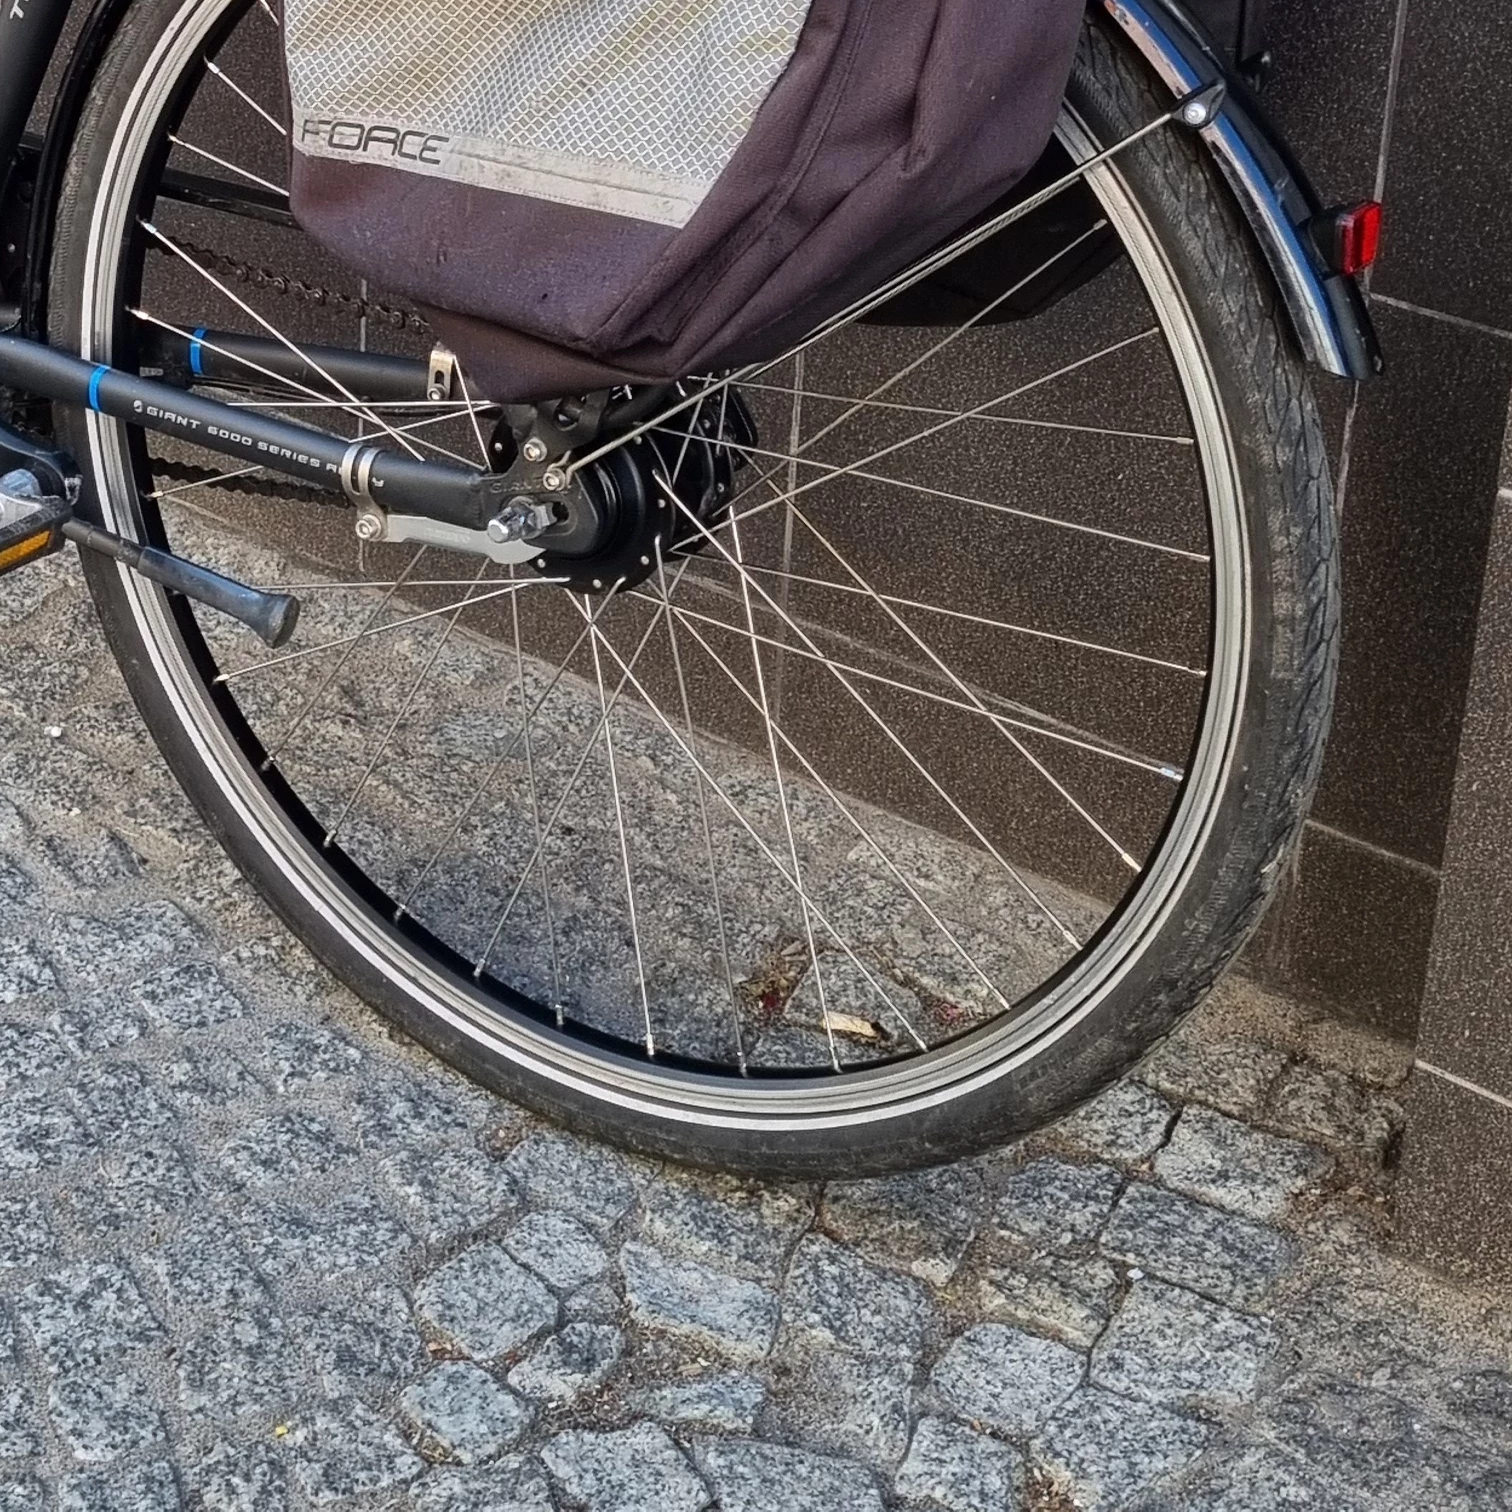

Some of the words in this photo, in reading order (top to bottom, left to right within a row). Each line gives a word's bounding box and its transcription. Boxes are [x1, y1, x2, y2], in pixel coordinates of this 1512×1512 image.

[301, 119, 449, 165] FORCE
[146, 405, 201, 430] GIANT
[207, 426, 253, 447] 6000
[257, 441, 321, 468] SERIES
